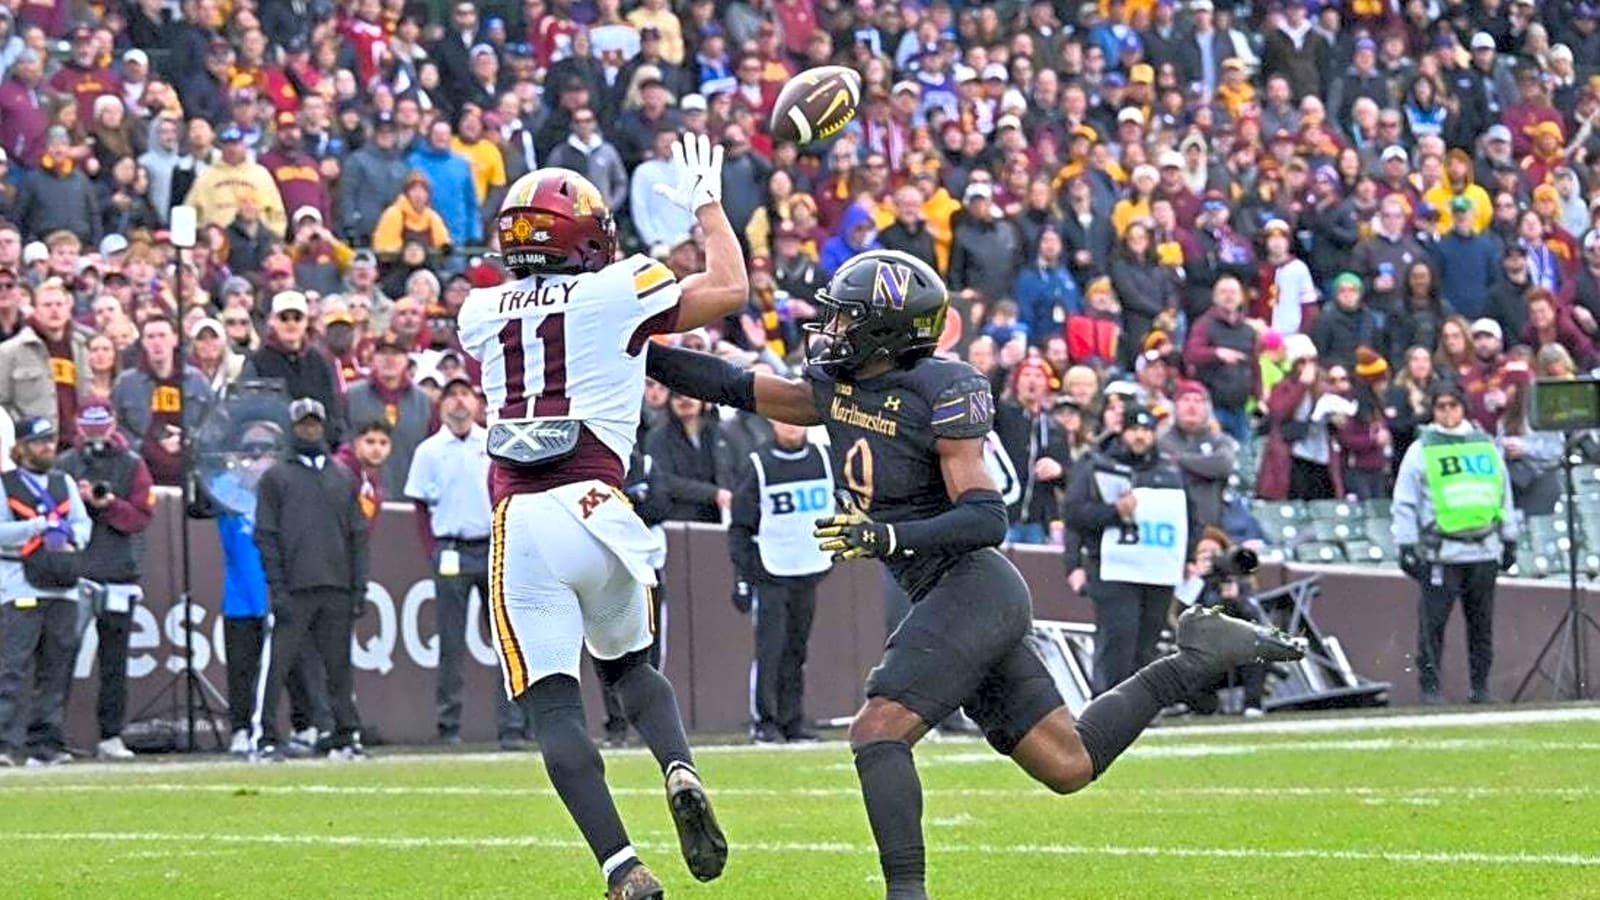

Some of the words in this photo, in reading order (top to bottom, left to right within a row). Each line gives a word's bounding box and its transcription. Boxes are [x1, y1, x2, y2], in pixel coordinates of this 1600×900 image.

[498, 280, 579, 314] TRACY
[872, 261, 912, 310] N
[498, 311, 571, 419] 11
[830, 395, 897, 437] Northwestern
